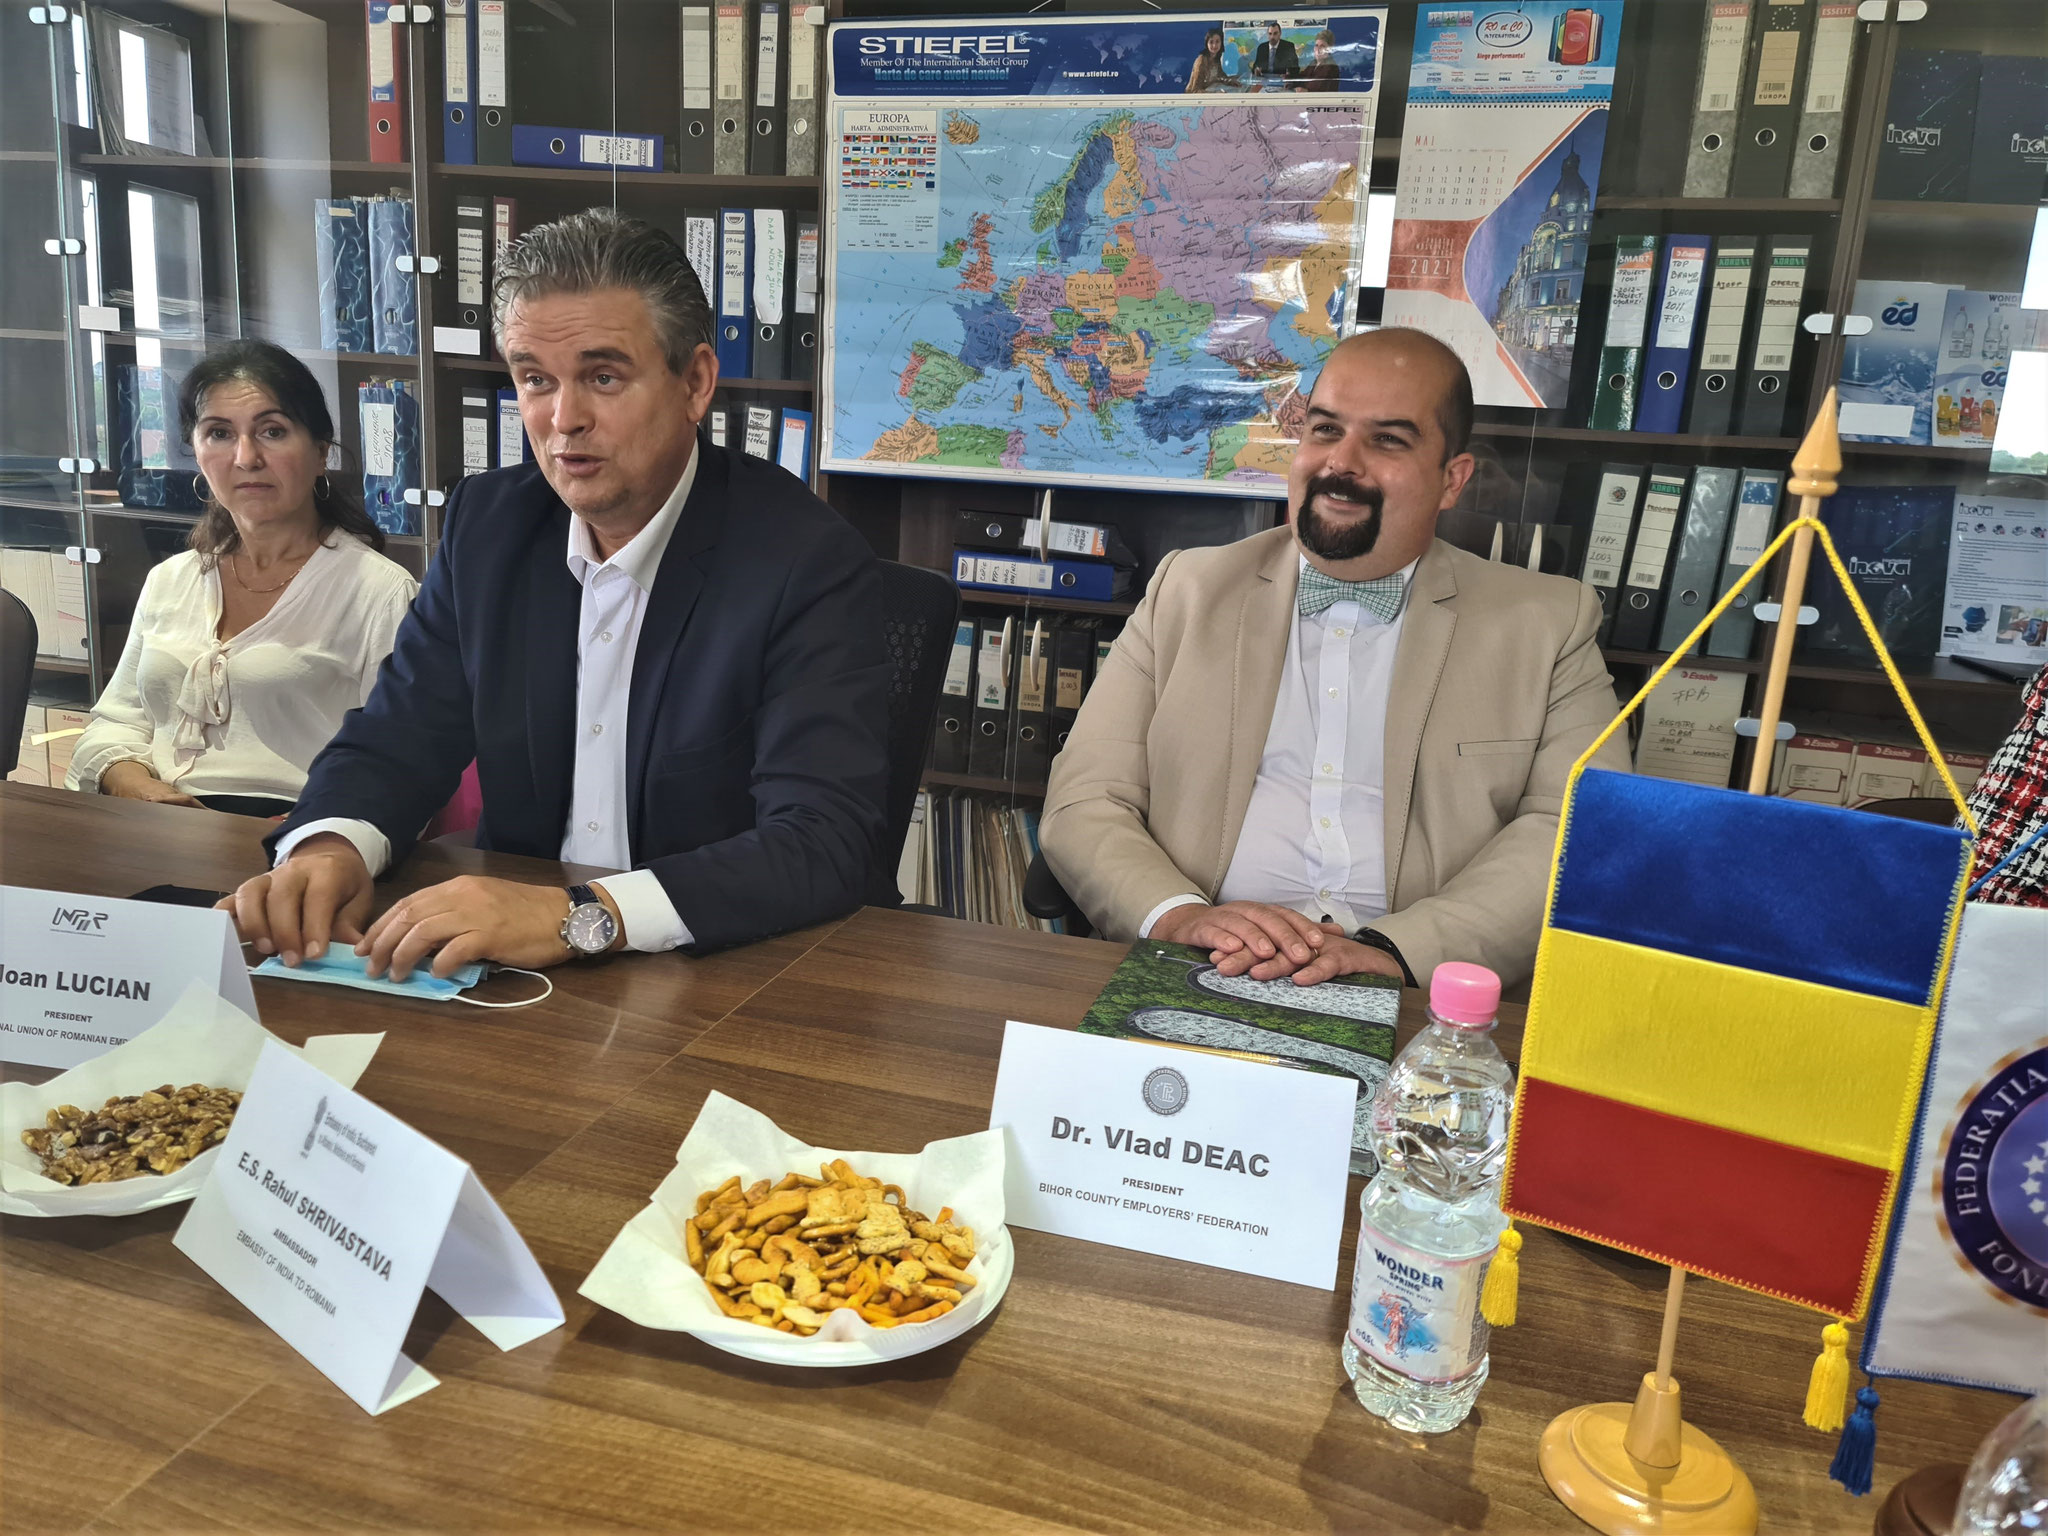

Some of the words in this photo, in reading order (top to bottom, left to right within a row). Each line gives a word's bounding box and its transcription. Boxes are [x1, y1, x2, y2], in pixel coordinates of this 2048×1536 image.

[1822, 8, 1851, 16] ESSELTE
[1484, 22, 1498, 32] RO
[1510, 21, 1524, 32] CO
[859, 36, 1030, 54] STIEFEL
[861, 58, 894, 66] Member
[896, 57, 906, 66] Of
[907, 58, 921, 66] The
[923, 58, 974, 66] International
[976, 57, 1000, 66] Stiefel
[1002, 58, 1028, 68] Group
[874, 68, 902, 80] Harta
[904, 68, 916, 80] de
[918, 71, 941, 80] care
[970, 68, 1009, 80] nevoie!
[868, 114, 910, 124] EUROPA
[877, 124, 928, 132] ADMINISTRATIVĂ
[1620, 255, 1650, 263] SMART
[1410, 258, 1450, 275] 2021
[1988, 294, 2018, 302] WOND
[1096, 530, 1105, 552] SMART
[1589, 552, 1612, 563] 2003
[1689, 672, 1718, 681] Esselte
[1811, 739, 1839, 748] Esselte
[1882, 747, 1911, 758] Esselte
[1954, 755, 1983, 765] Esselte
[56, 971, 151, 1001] LUCIAN
[44, 1010, 93, 1023] PRESIDENT
[17, 1025, 44, 1037] UNION
[46, 1029, 58, 1038] OF
[60, 1030, 107, 1044] ROMANIAN
[1051, 1116, 1091, 1145] Dr.
[1104, 1126, 1171, 1159] Vlad
[1182, 1140, 1270, 1178] DEAC
[1122, 1177, 1184, 1196] PRESIDENT
[1039, 1183, 1073, 1198] BIHOR
[1075, 1190, 1120, 1207] COUNTY
[1196, 1213, 1268, 1236] FEDERATION
[238, 1152, 259, 1180] E.S.
[261, 1170, 299, 1208] Rahul
[297, 1197, 393, 1282] SHRIVASTAVA
[272, 1228, 318, 1268] AMBASSADOR
[236, 1230, 267, 1260] EMBASSY
[266, 1254, 276, 1267] OF
[276, 1262, 294, 1284] INDIA
[295, 1276, 305, 1291] TO
[304, 1284, 337, 1318] ROMANIA
[1374, 1248, 1444, 1291] WONDER
[1390, 1272, 1421, 1292] SPRING
